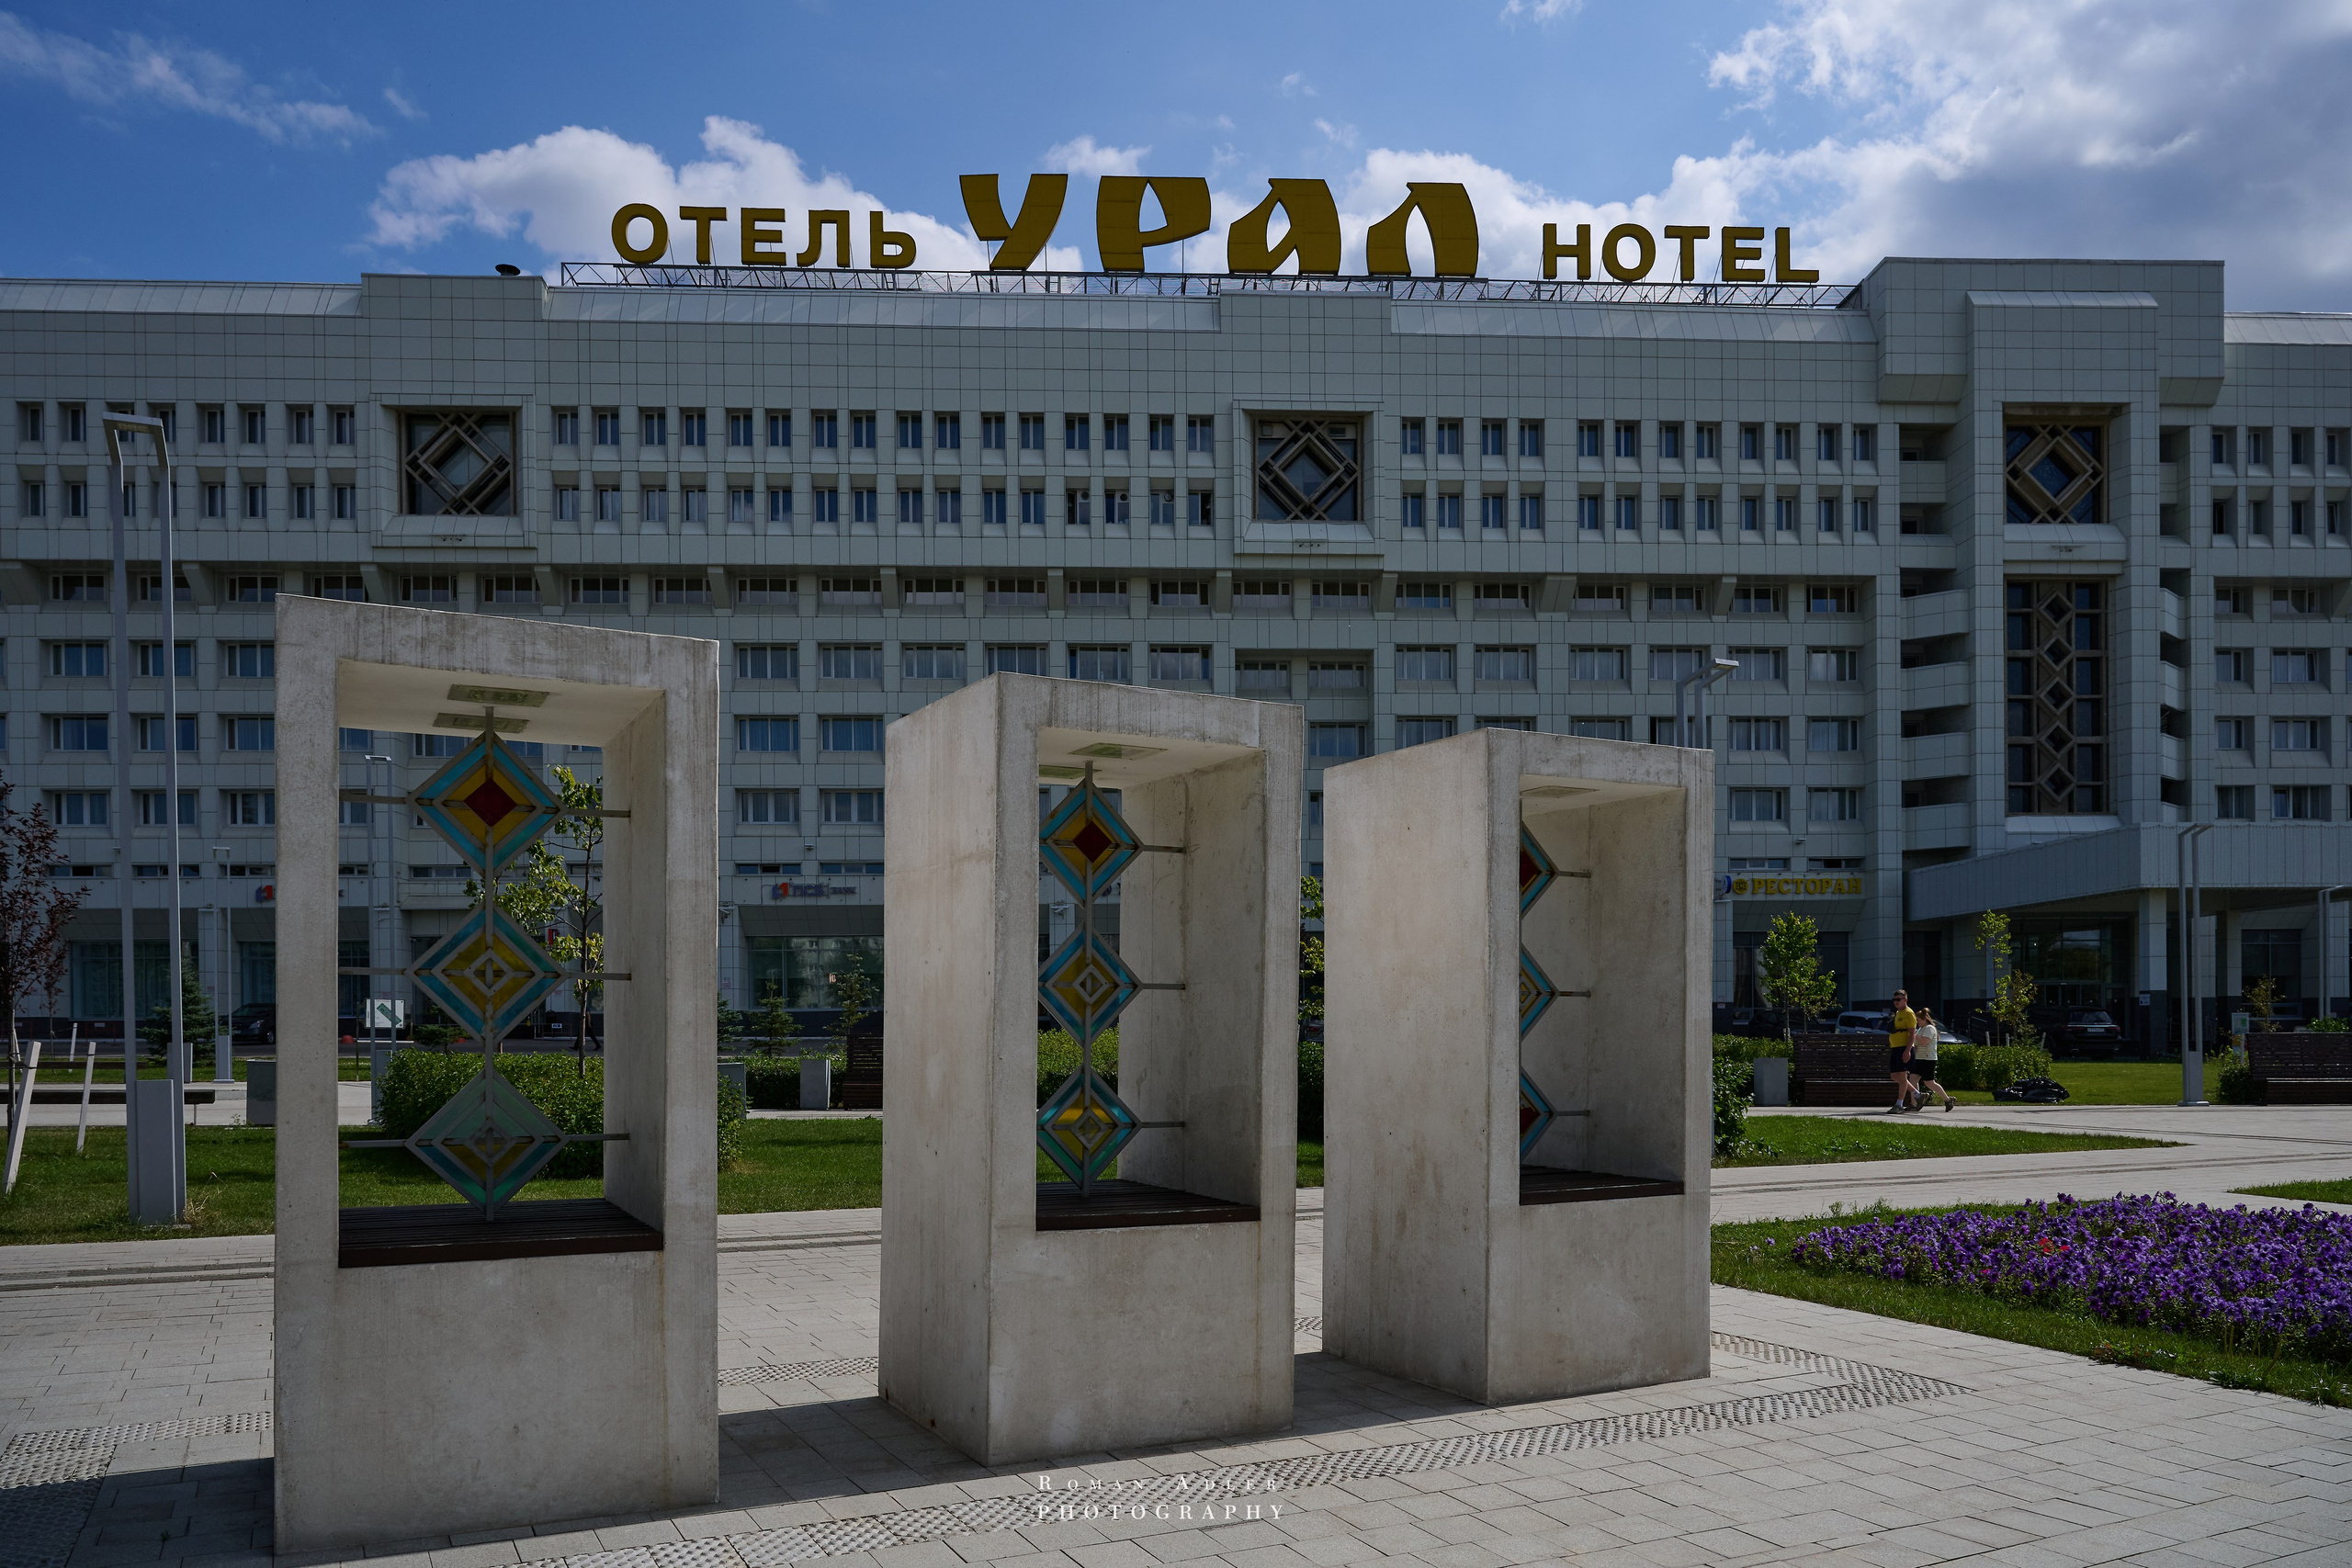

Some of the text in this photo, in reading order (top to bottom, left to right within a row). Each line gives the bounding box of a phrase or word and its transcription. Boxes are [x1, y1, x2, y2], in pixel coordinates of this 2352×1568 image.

[611, 174, 1479, 277] ОТЕЛЬ УРАЛ
[1543, 223, 1820, 283] HOTEL
[793, 885, 825, 897] ПСБ
[1752, 877, 1862, 895] РЕСТОРАН
